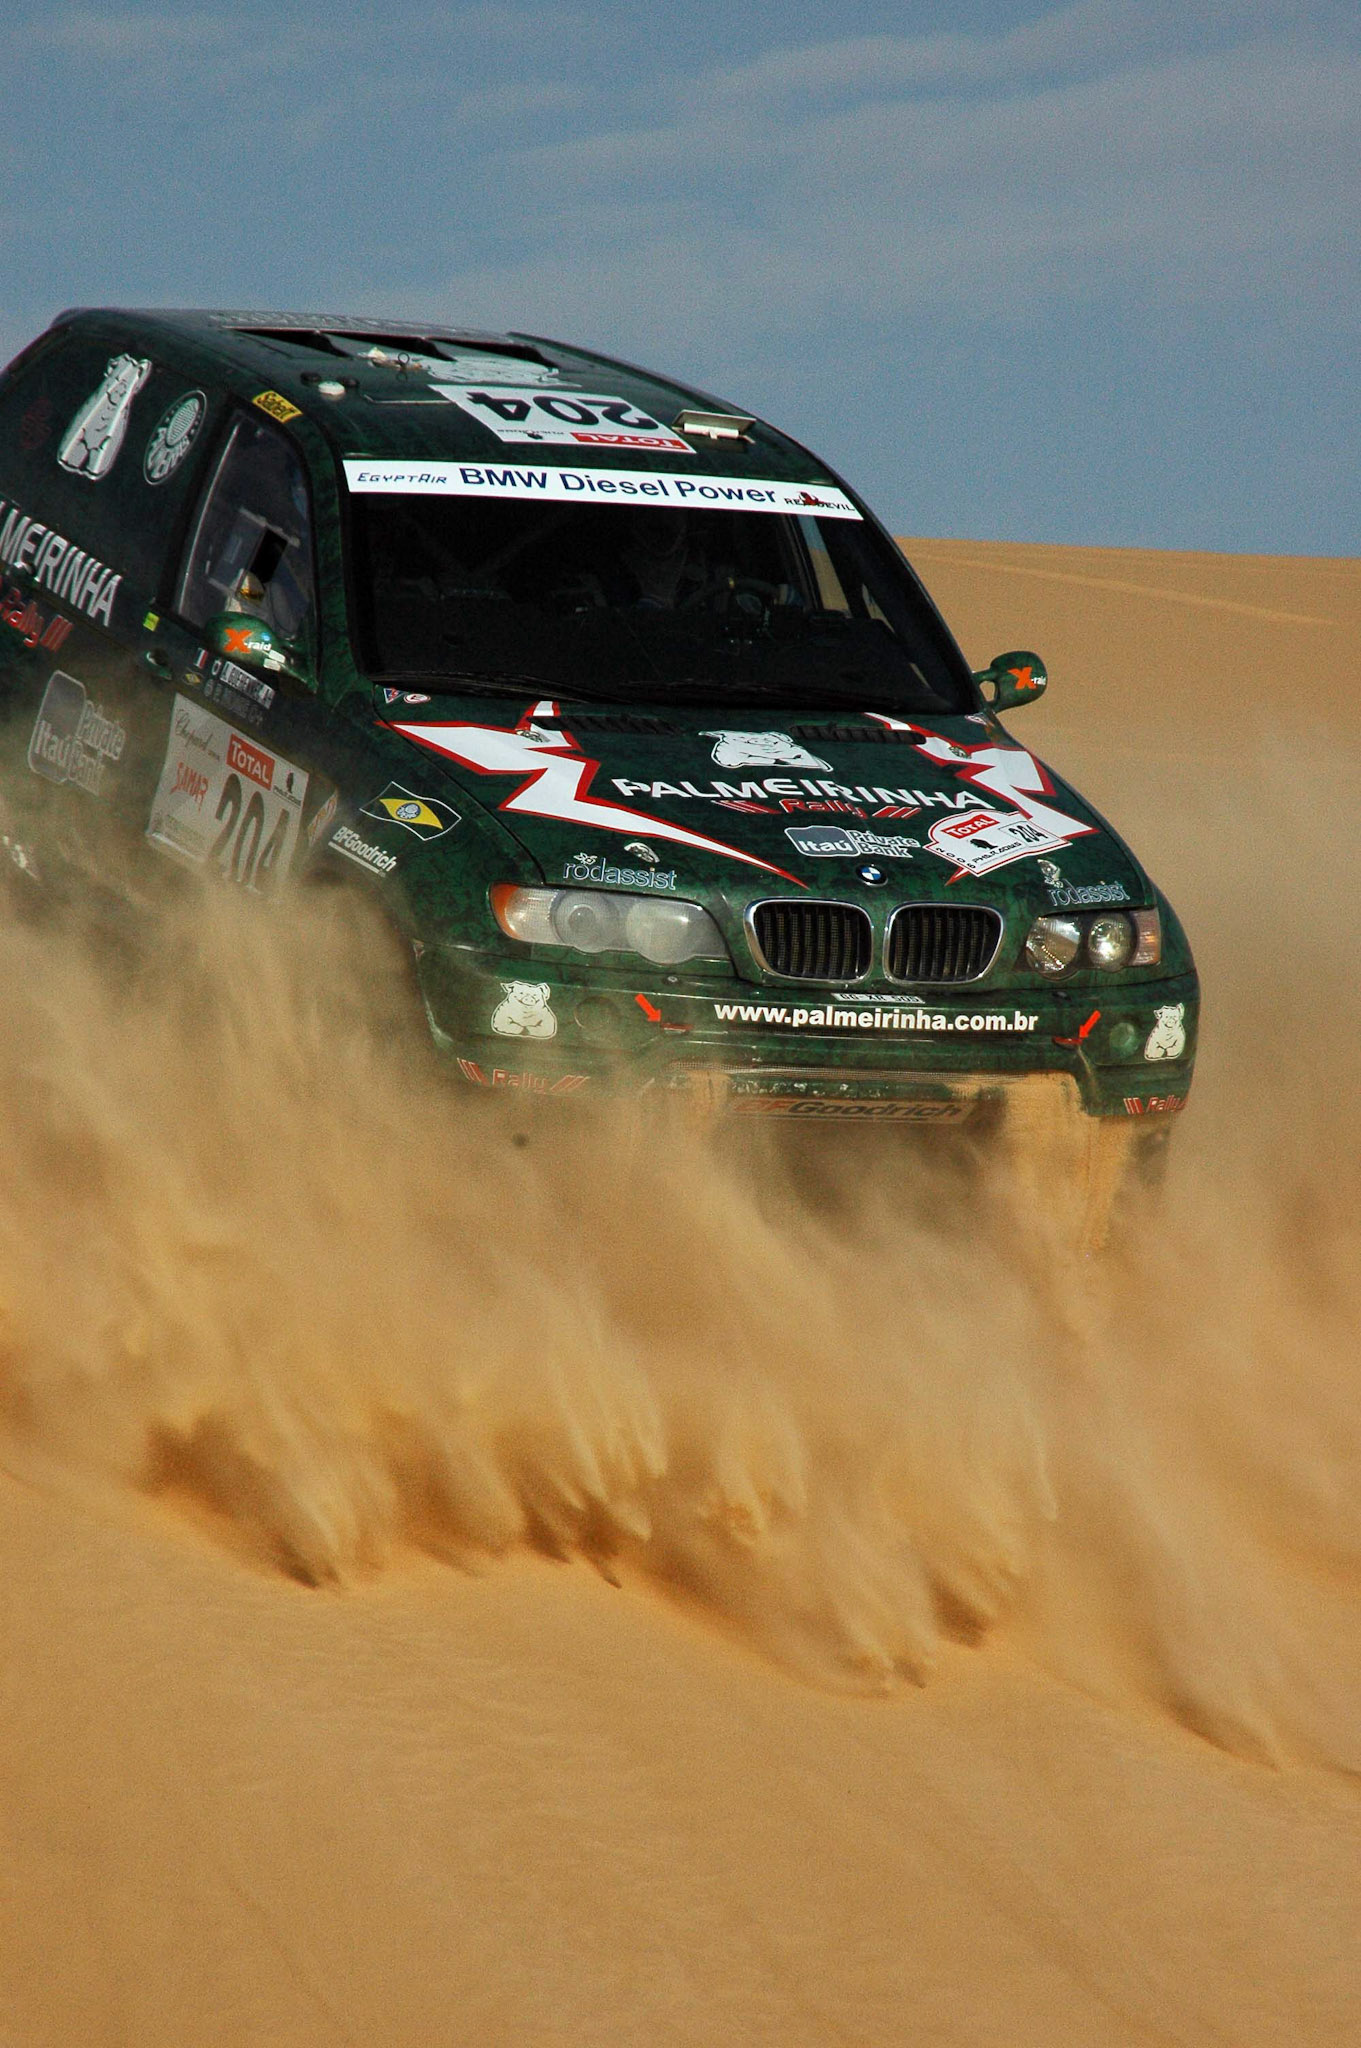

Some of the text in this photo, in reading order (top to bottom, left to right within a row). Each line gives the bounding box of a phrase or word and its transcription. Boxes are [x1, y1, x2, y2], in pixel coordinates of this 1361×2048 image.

[466, 391, 660, 430] 204
[572, 432, 683, 449] TOTAL
[459, 467, 547, 489] BMW
[559, 473, 669, 497] Diesel
[674, 479, 776, 503] Power
[0, 500, 122, 628] MEIRINHA
[231, 740, 270, 784] TOTAL
[611, 778, 996, 810] PALMEIRINHA
[780, 798, 869, 820] Rally
[850, 831, 921, 848] Private
[946, 817, 996, 837] TOTAL
[1008, 824, 1049, 843] 204
[331, 825, 398, 872] BFGoodrich
[798, 839, 853, 852] Itaú
[858, 842, 914, 858] Bank
[562, 857, 678, 890] rodassist
[1047, 878, 1131, 907] rodassist
[714, 1003, 1039, 1031] www.palmeirinha.com.br
